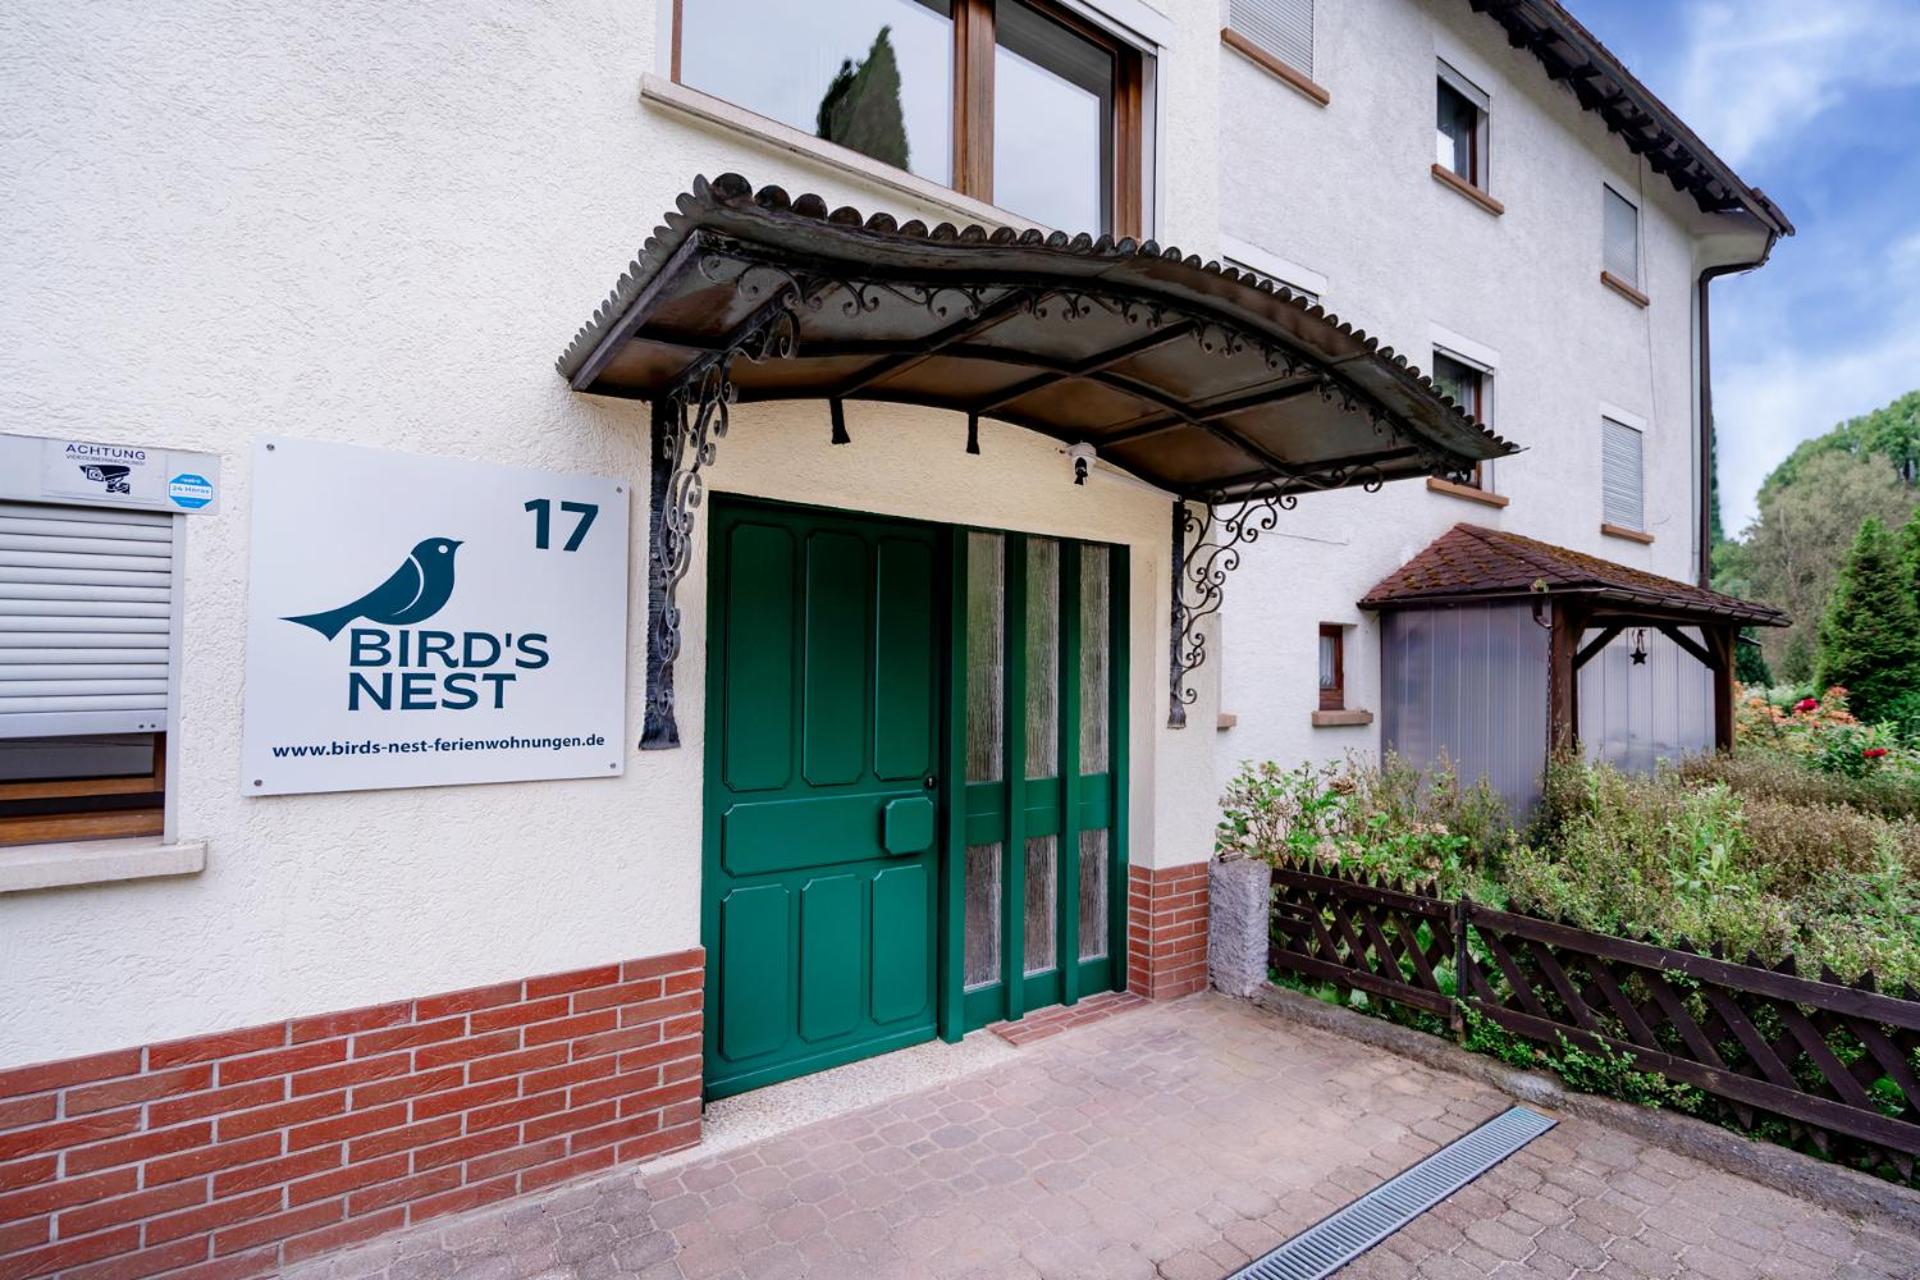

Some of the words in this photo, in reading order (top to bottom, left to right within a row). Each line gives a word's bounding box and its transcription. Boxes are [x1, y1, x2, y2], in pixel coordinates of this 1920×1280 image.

[66, 444, 146, 460] ACHTUNG
[525, 499, 598, 552] 17
[350, 628, 549, 670] BIRD'S
[348, 672, 516, 711] NEST
[272, 733, 605, 758] www.birds-nest-ferienwohnungen.de
